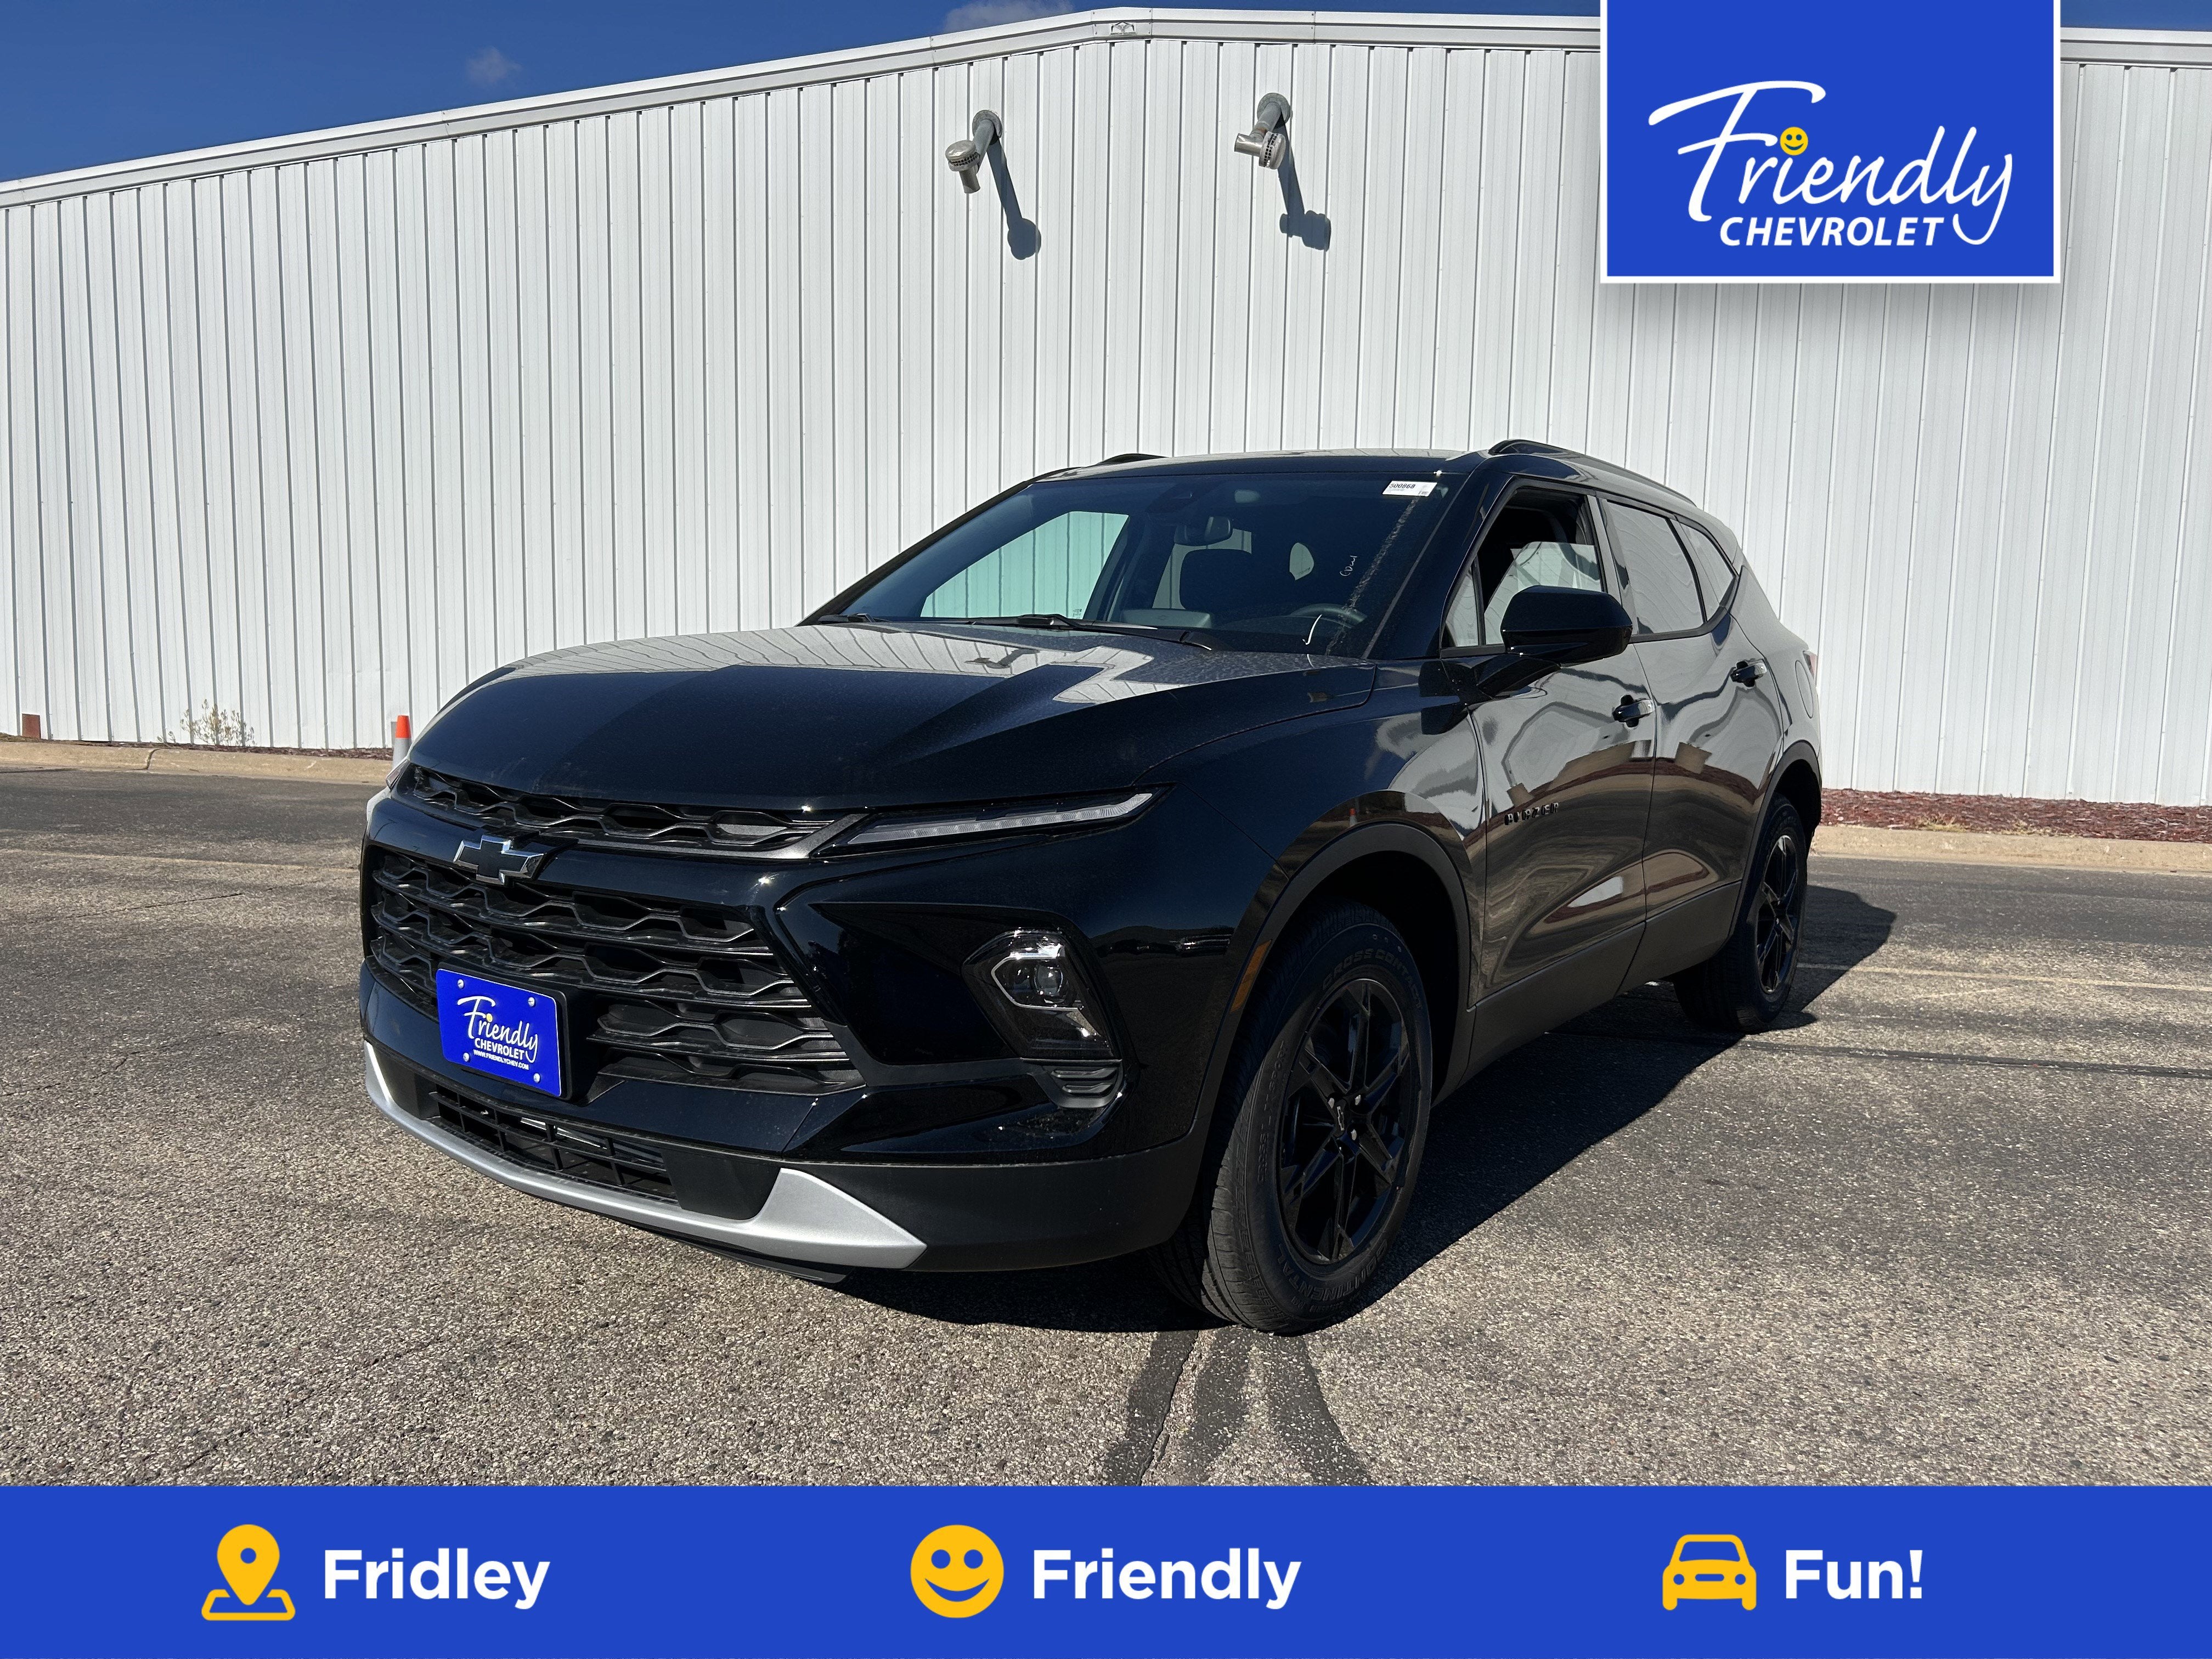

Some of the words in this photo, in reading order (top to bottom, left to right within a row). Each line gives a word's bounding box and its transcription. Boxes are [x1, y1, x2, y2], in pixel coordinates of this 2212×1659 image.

[457, 996, 538, 1063] Friendly
[474, 1037, 524, 1060] CHEVROLET
[1277, 1239, 1388, 1302] CONTINENTAL
